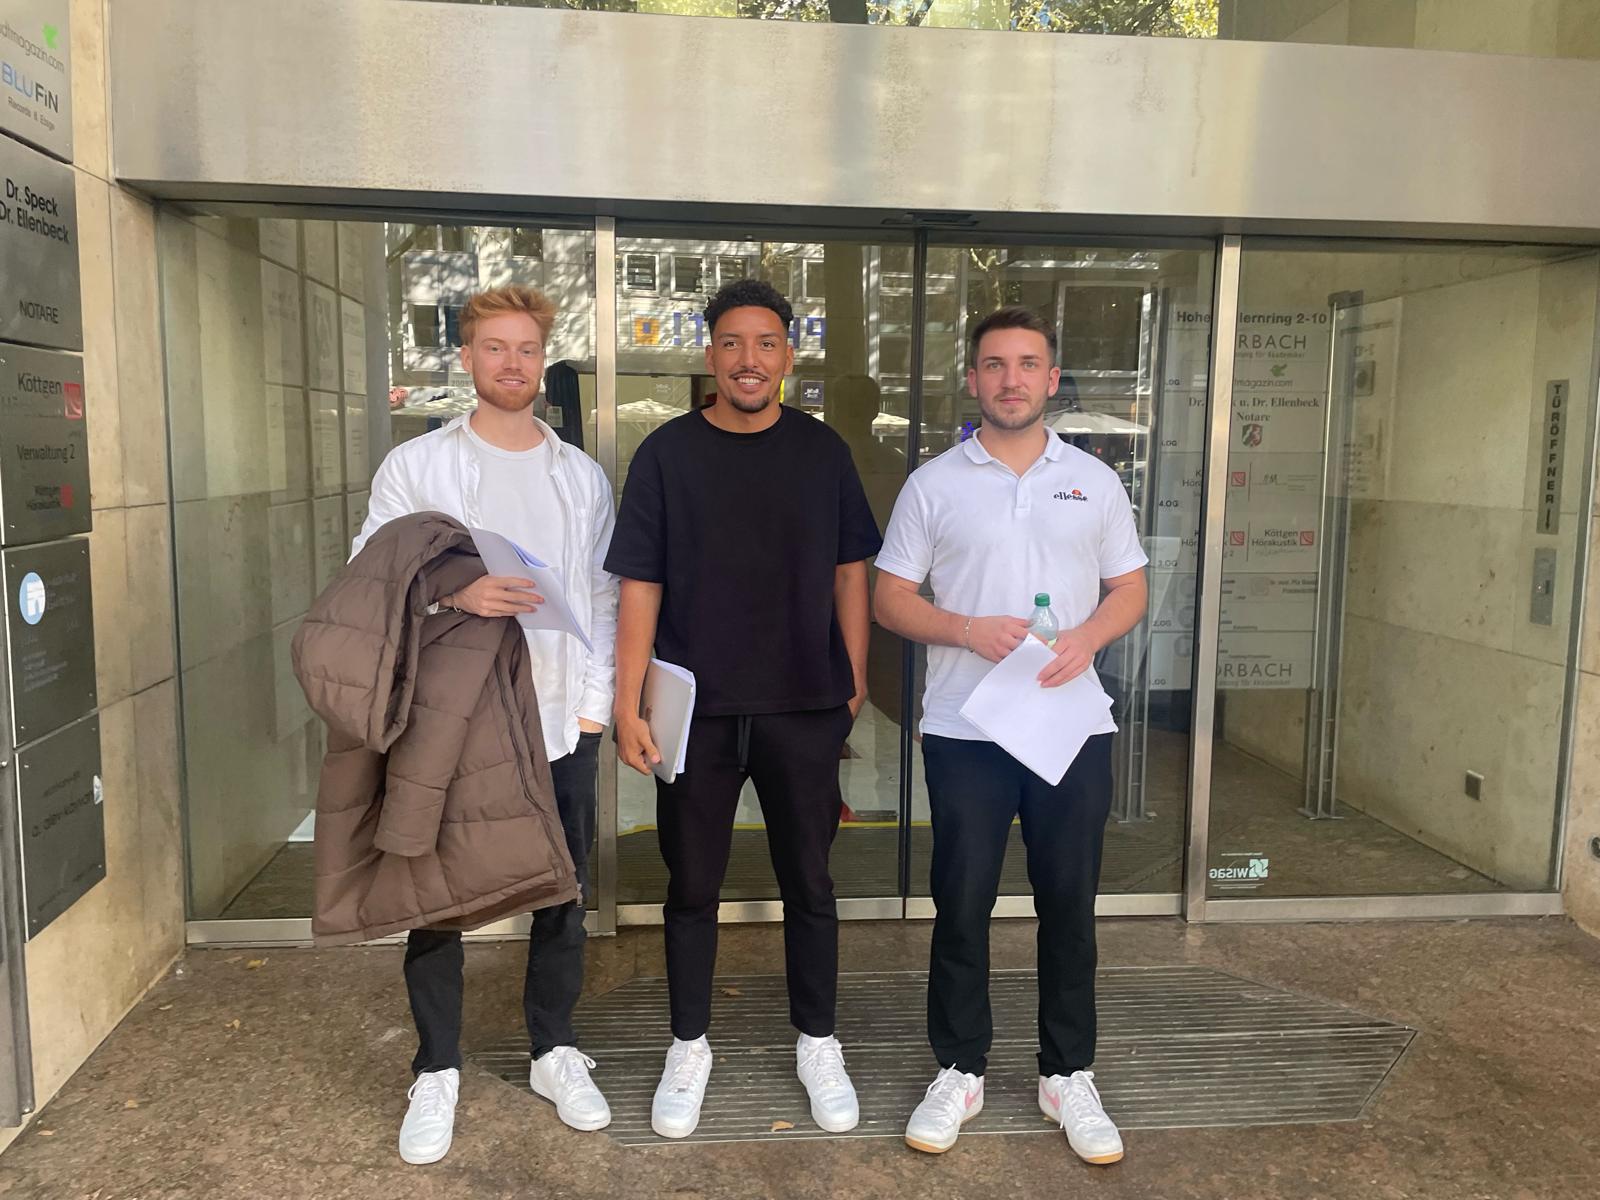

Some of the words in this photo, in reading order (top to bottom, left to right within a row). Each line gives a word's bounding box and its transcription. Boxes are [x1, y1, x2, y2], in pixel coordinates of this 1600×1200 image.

[6, 178, 21, 200] Dr.
[25, 186, 58, 217] Speck
[0, 203, 13, 223] Dr.
[17, 209, 69, 243] Ellenbeck
[19, 300, 58, 324] NOTARE
[1296, 312, 1327, 324] 2-10
[18, 373, 62, 397] Köttgen
[1188, 397, 1204, 407] Dr.
[1252, 398, 1268, 407] Dr.
[1271, 397, 1319, 408] Ellenbeck
[1236, 412, 1271, 422] Notare
[1264, 529, 1298, 540] Köttgen
